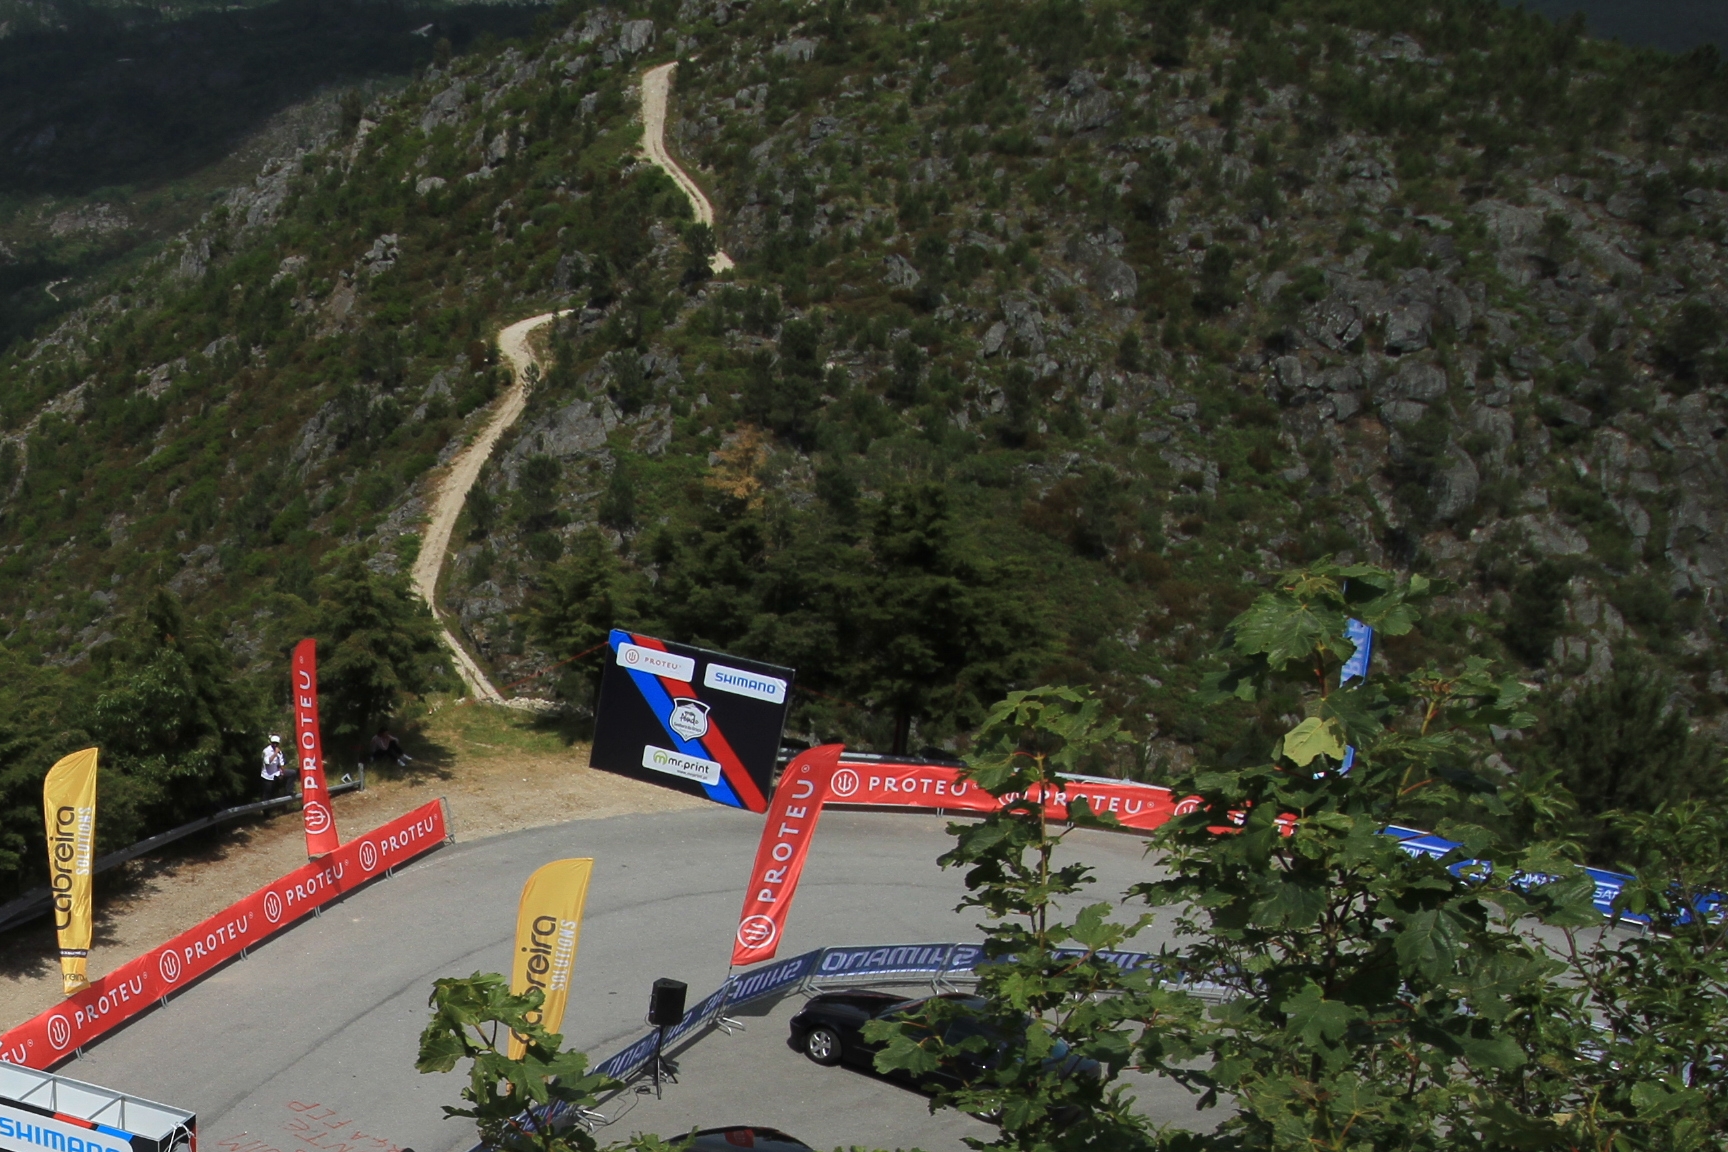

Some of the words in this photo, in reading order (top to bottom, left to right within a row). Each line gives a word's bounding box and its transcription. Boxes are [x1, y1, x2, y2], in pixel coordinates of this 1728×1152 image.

[645, 656, 679, 671] PROTEU
[715, 672, 776, 694] SHIMANO
[299, 670, 319, 790] PROTEU
[668, 758, 709, 774] mr.print
[869, 776, 967, 797] PROTEU
[1038, 789, 1143, 815] PRTEU
[76, 806, 92, 876] SOLUTIONS
[381, 817, 435, 857] PROTEU
[758, 778, 815, 903] PROTEU
[286, 860, 344, 906] PROTEU
[185, 914, 249, 965] PROTEU
[550, 919, 576, 992] SOLUTIONS
[76, 975, 143, 1029] PROTEU
[510, 915, 557, 1045] Careira
